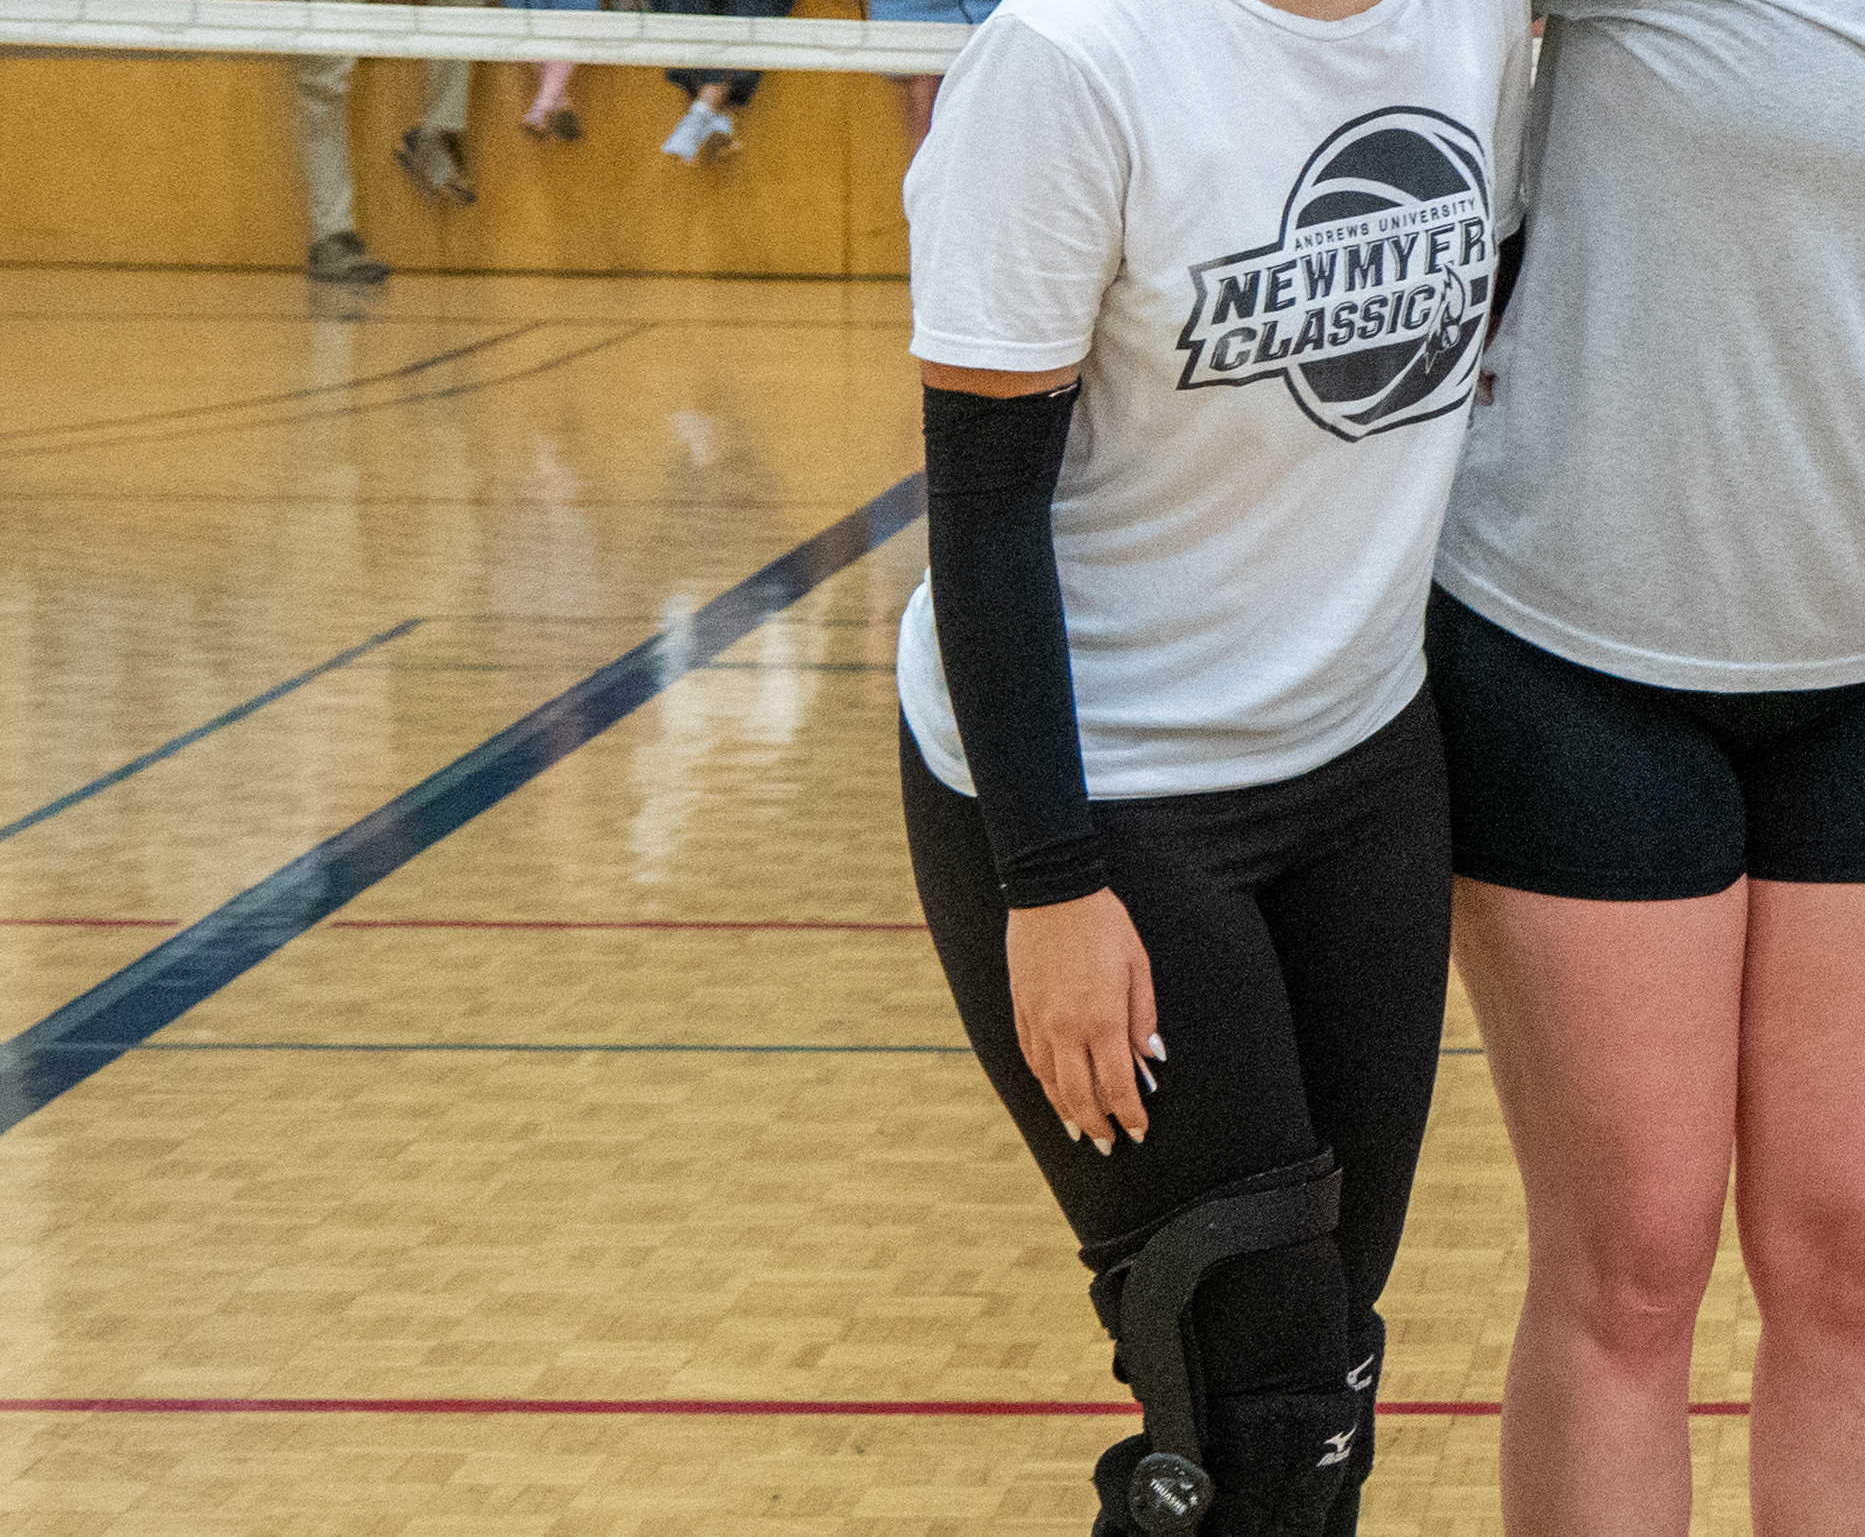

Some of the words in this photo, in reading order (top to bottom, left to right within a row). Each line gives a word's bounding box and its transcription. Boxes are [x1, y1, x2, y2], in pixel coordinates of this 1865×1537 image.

[1294, 222, 1370, 251] ANDREWS
[1378, 197, 1477, 232] UNIVERSITY
[1210, 216, 1486, 326] NEWMYER
[1209, 283, 1437, 372] CLASSIC
